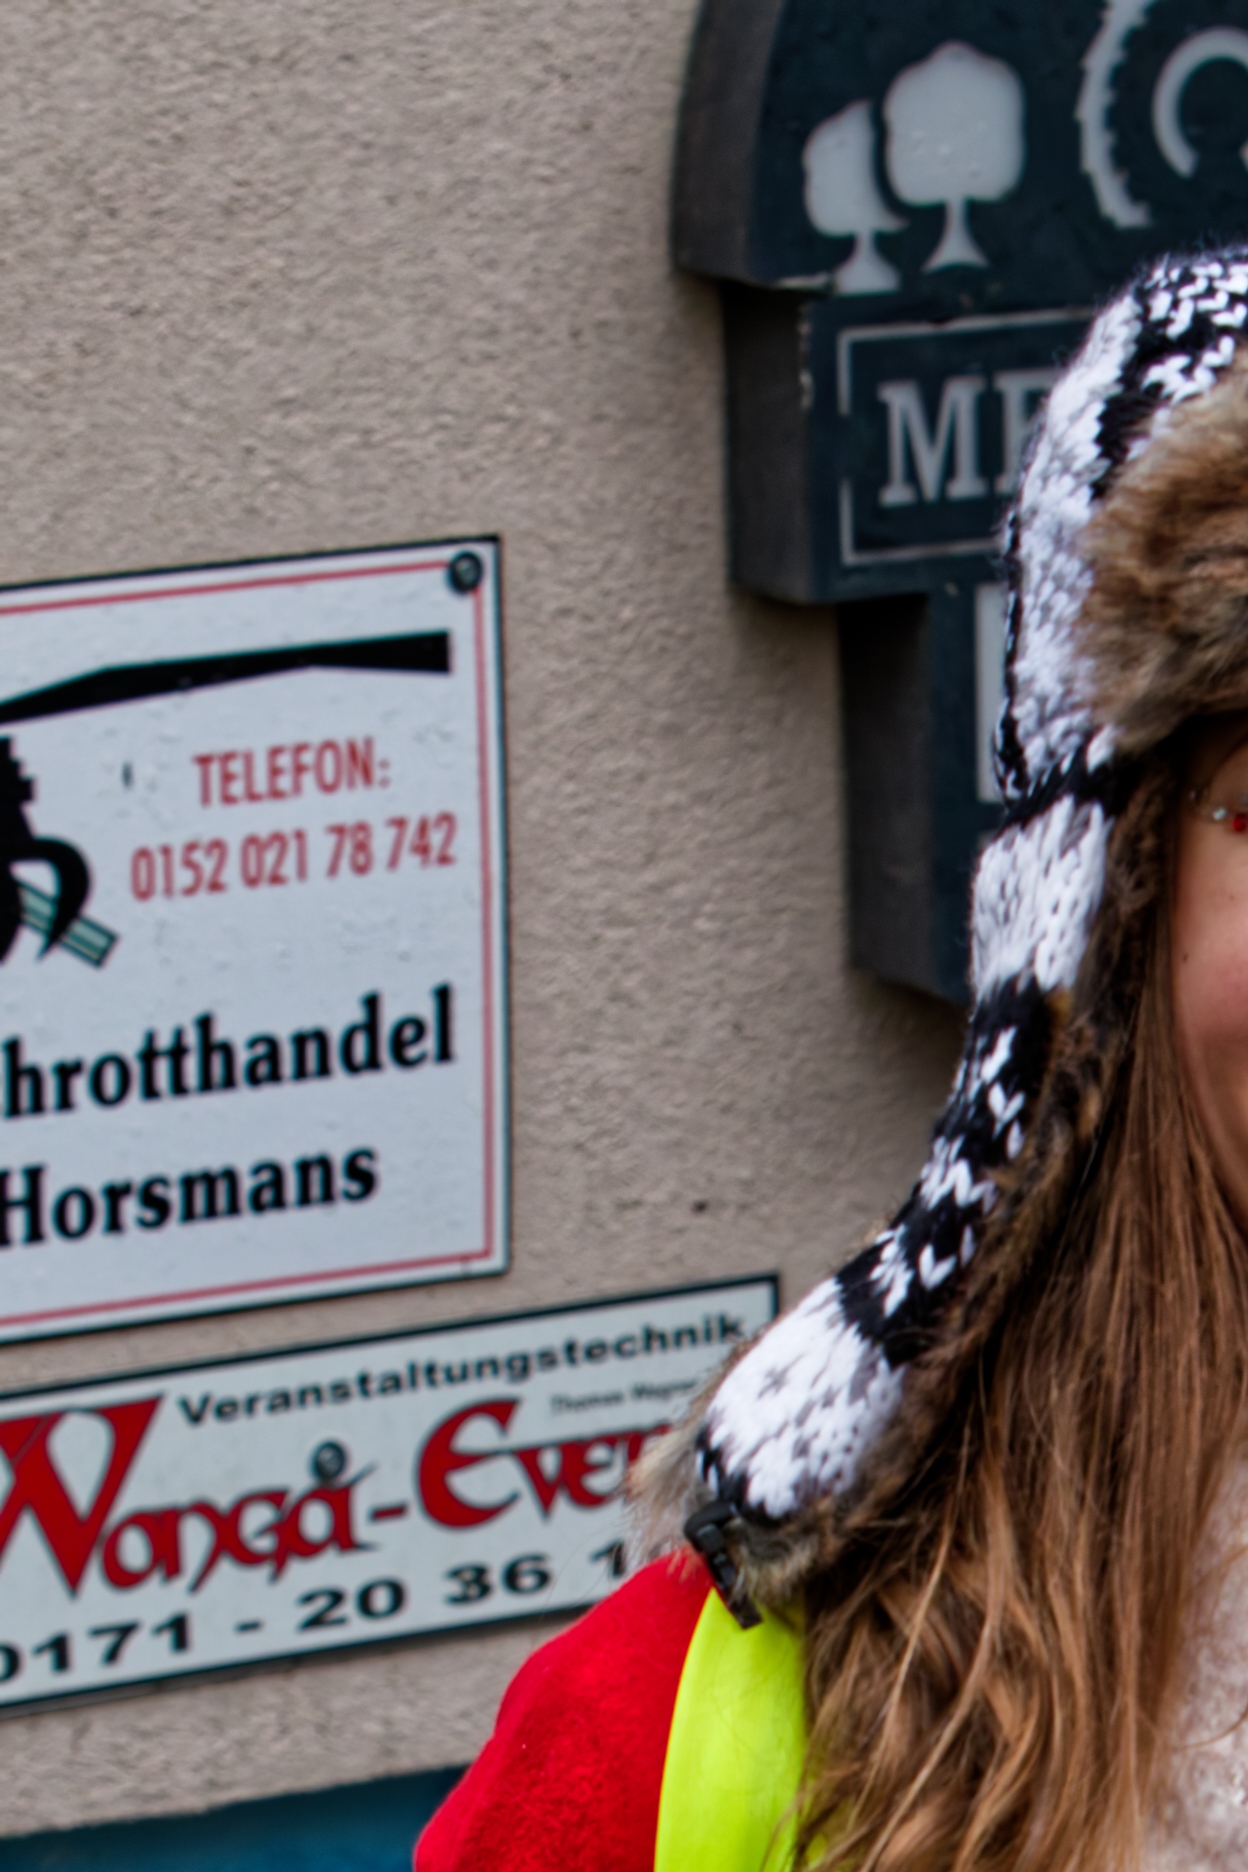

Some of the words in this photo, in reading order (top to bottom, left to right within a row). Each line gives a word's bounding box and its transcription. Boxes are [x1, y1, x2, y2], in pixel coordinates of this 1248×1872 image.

[194, 737, 390, 807] TELEFON:
[131, 838, 228, 903] 0152
[240, 829, 308, 890] 021
[326, 821, 374, 878] 78
[386, 811, 459, 871] 742
[3, 983, 455, 1121] hrotthandel
[0, 1147, 379, 1248] Horsmans
[181, 1313, 743, 1427] Veranstaltungstechnik
[299, 1577, 405, 1633] 20
[444, 1553, 552, 1606] 36
